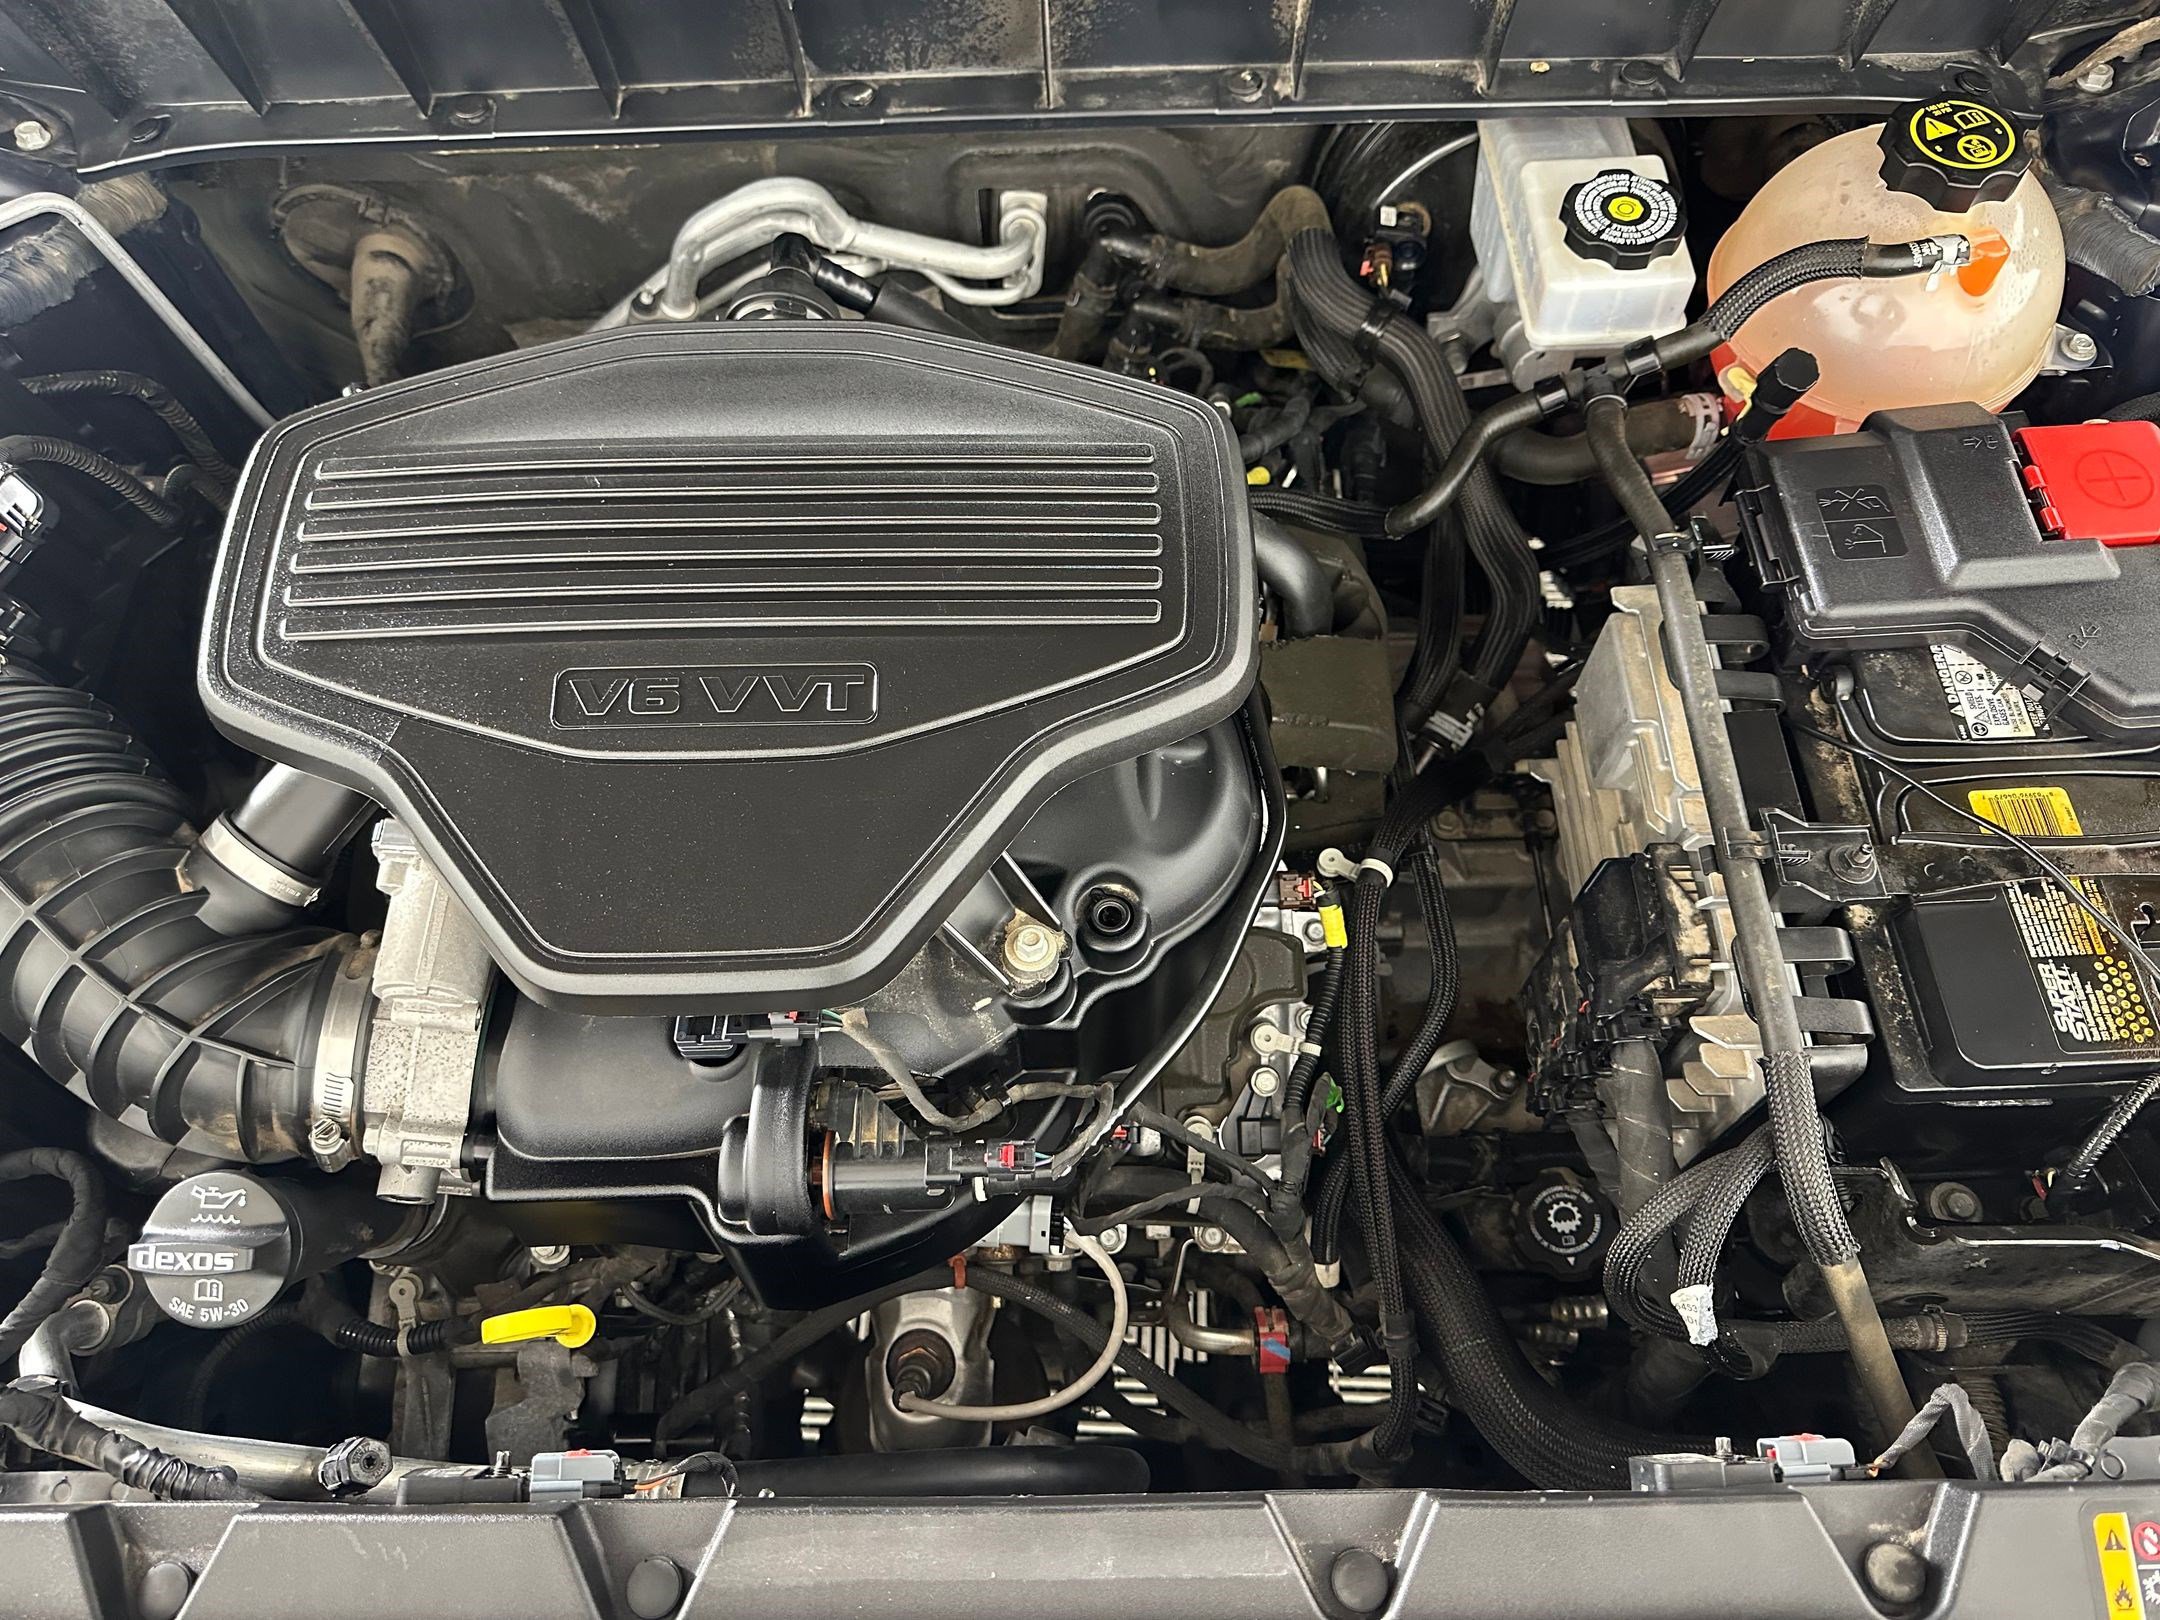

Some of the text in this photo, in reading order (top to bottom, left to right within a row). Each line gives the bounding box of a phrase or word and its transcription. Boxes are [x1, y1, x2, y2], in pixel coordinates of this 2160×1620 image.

[569, 674, 865, 716] V6 VVT
[1965, 692, 1977, 710] SHIELD
[1986, 698, 2002, 725] EXPLOSIVE
[1998, 708, 2010, 725] GASES
[2029, 712, 2041, 727] KEEP
[2038, 963, 2069, 1032] SUPER
[2051, 960, 2085, 1041] START
[136, 1246, 234, 1271] dexos
[169, 1297, 249, 1322] SAE 5W-30
